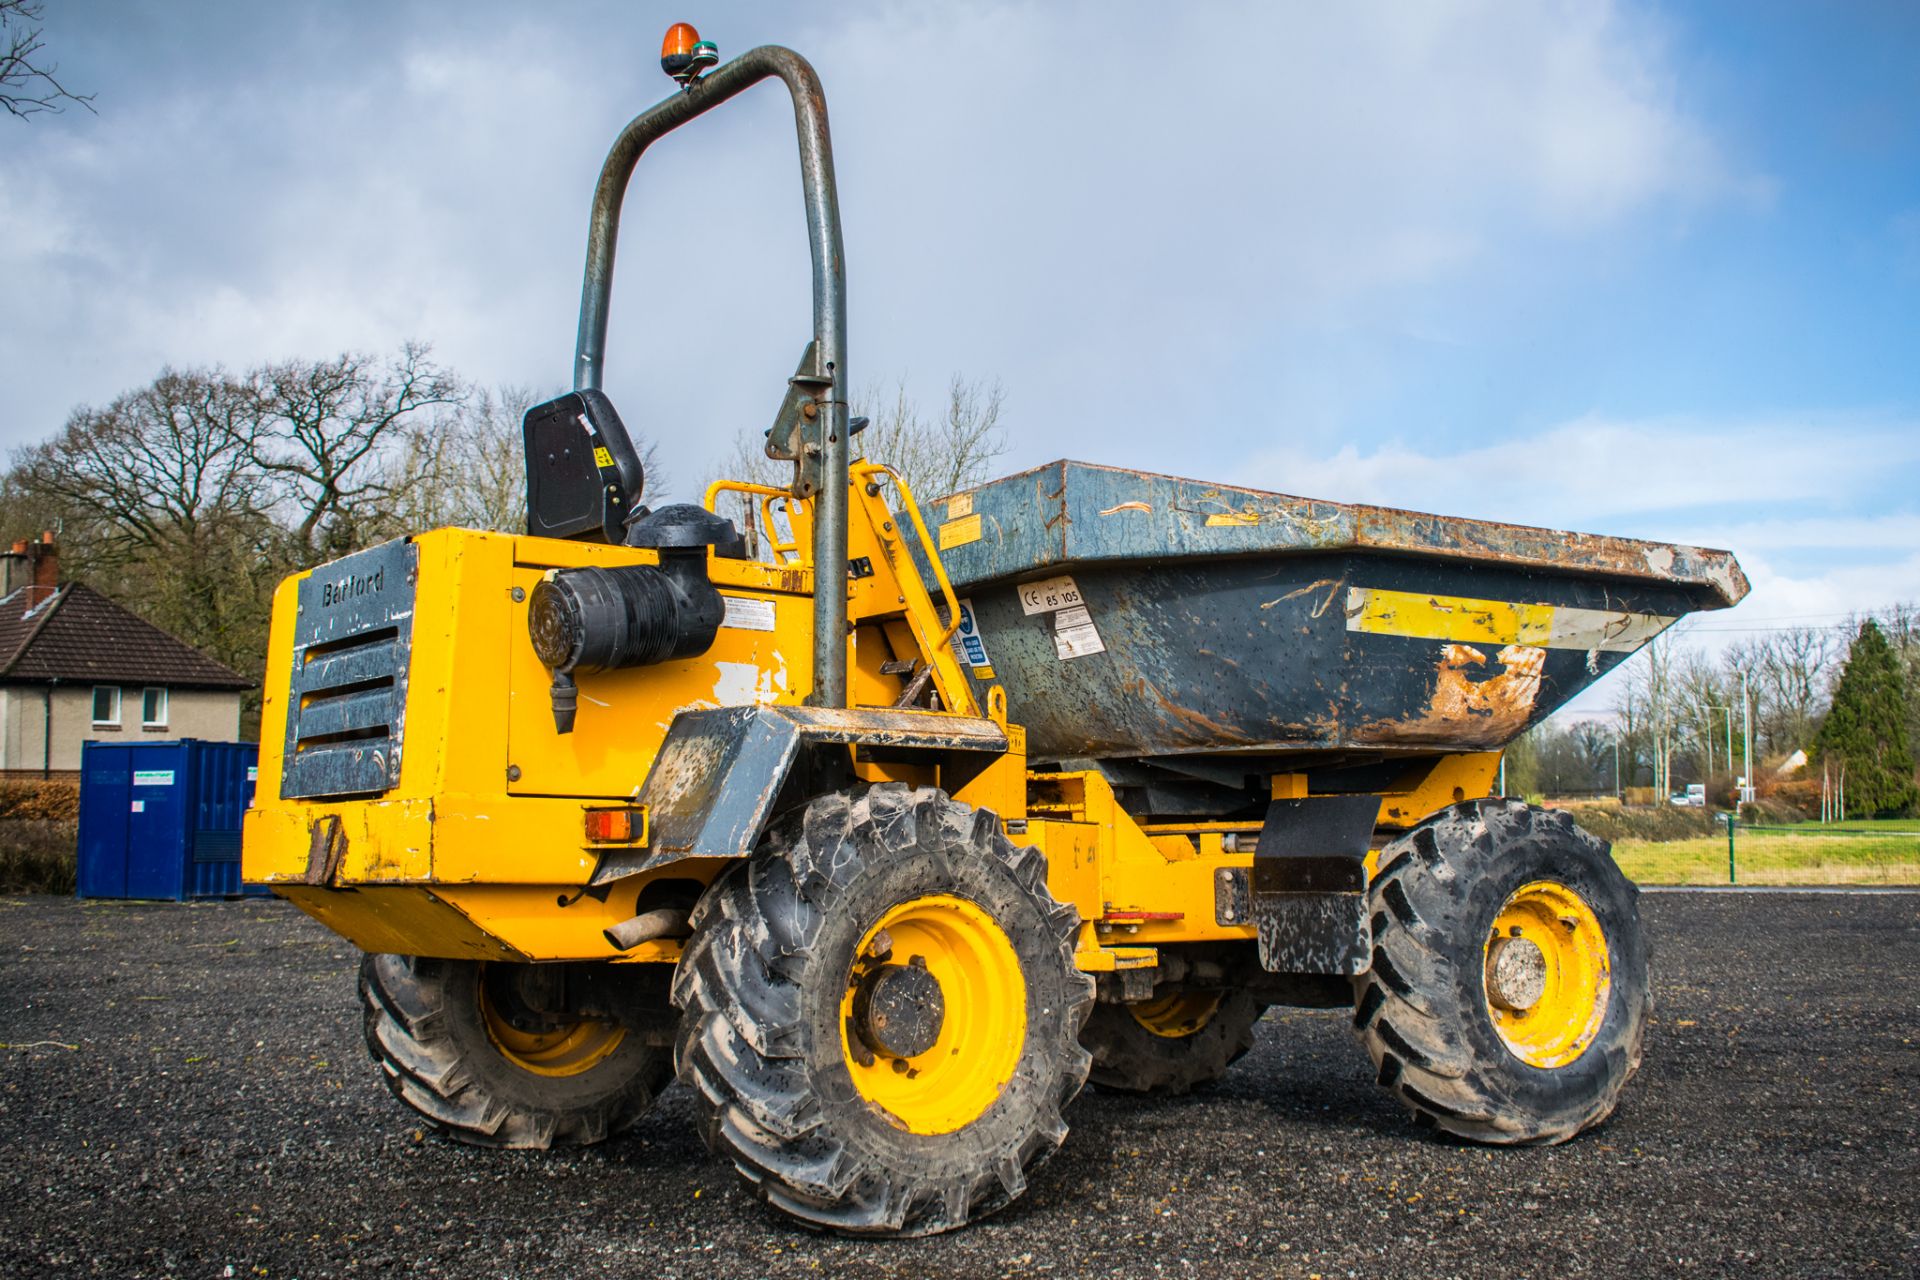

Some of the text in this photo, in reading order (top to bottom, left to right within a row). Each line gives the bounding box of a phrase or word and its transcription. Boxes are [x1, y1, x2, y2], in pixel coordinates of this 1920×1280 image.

[322, 566, 384, 608] Barford
[1046, 594, 1059, 607] 85
[1061, 591, 1079, 604] 105
